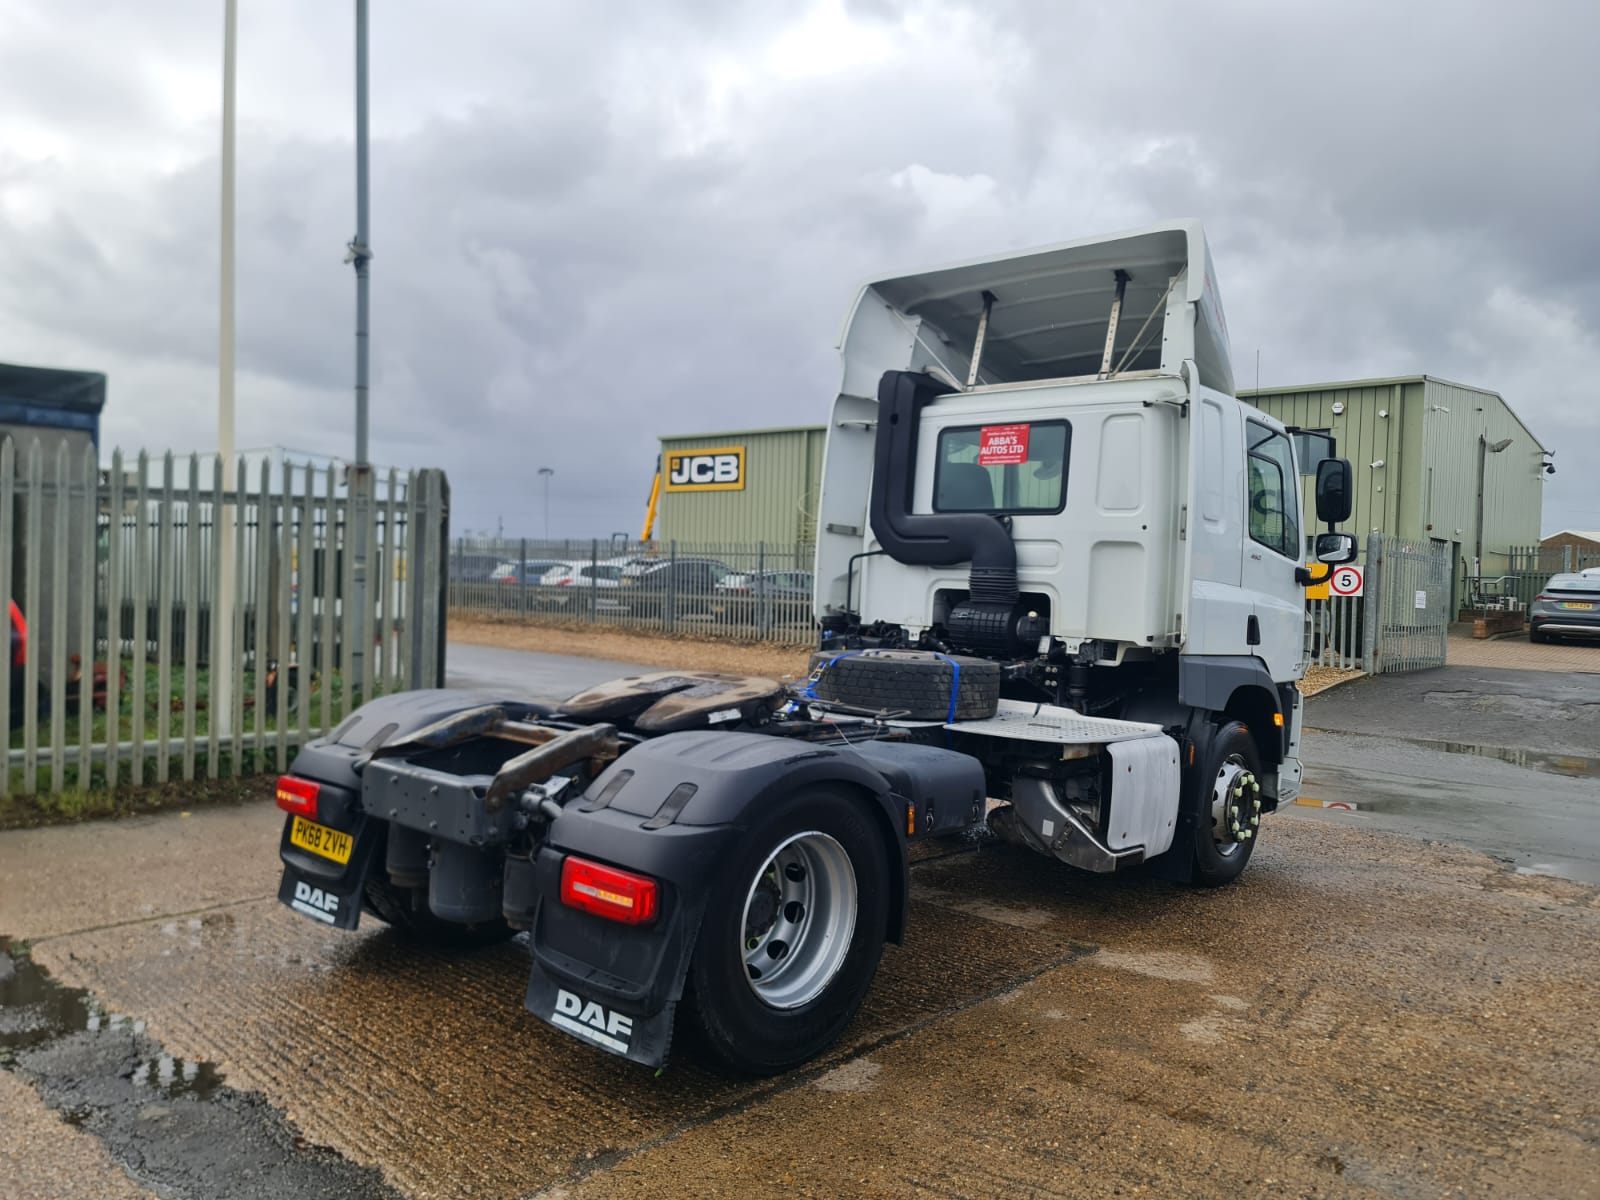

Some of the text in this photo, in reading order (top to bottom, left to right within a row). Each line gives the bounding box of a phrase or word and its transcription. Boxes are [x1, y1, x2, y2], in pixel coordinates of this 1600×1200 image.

[980, 444, 1025, 455] AUTOS LTD
[988, 435, 1018, 446] ABBA'S
[671, 455, 738, 484] JCB
[1341, 574, 1352, 587] 5
[295, 821, 349, 857] PK68 ZVH
[294, 880, 340, 912] DAF
[555, 988, 633, 1036] DAF
